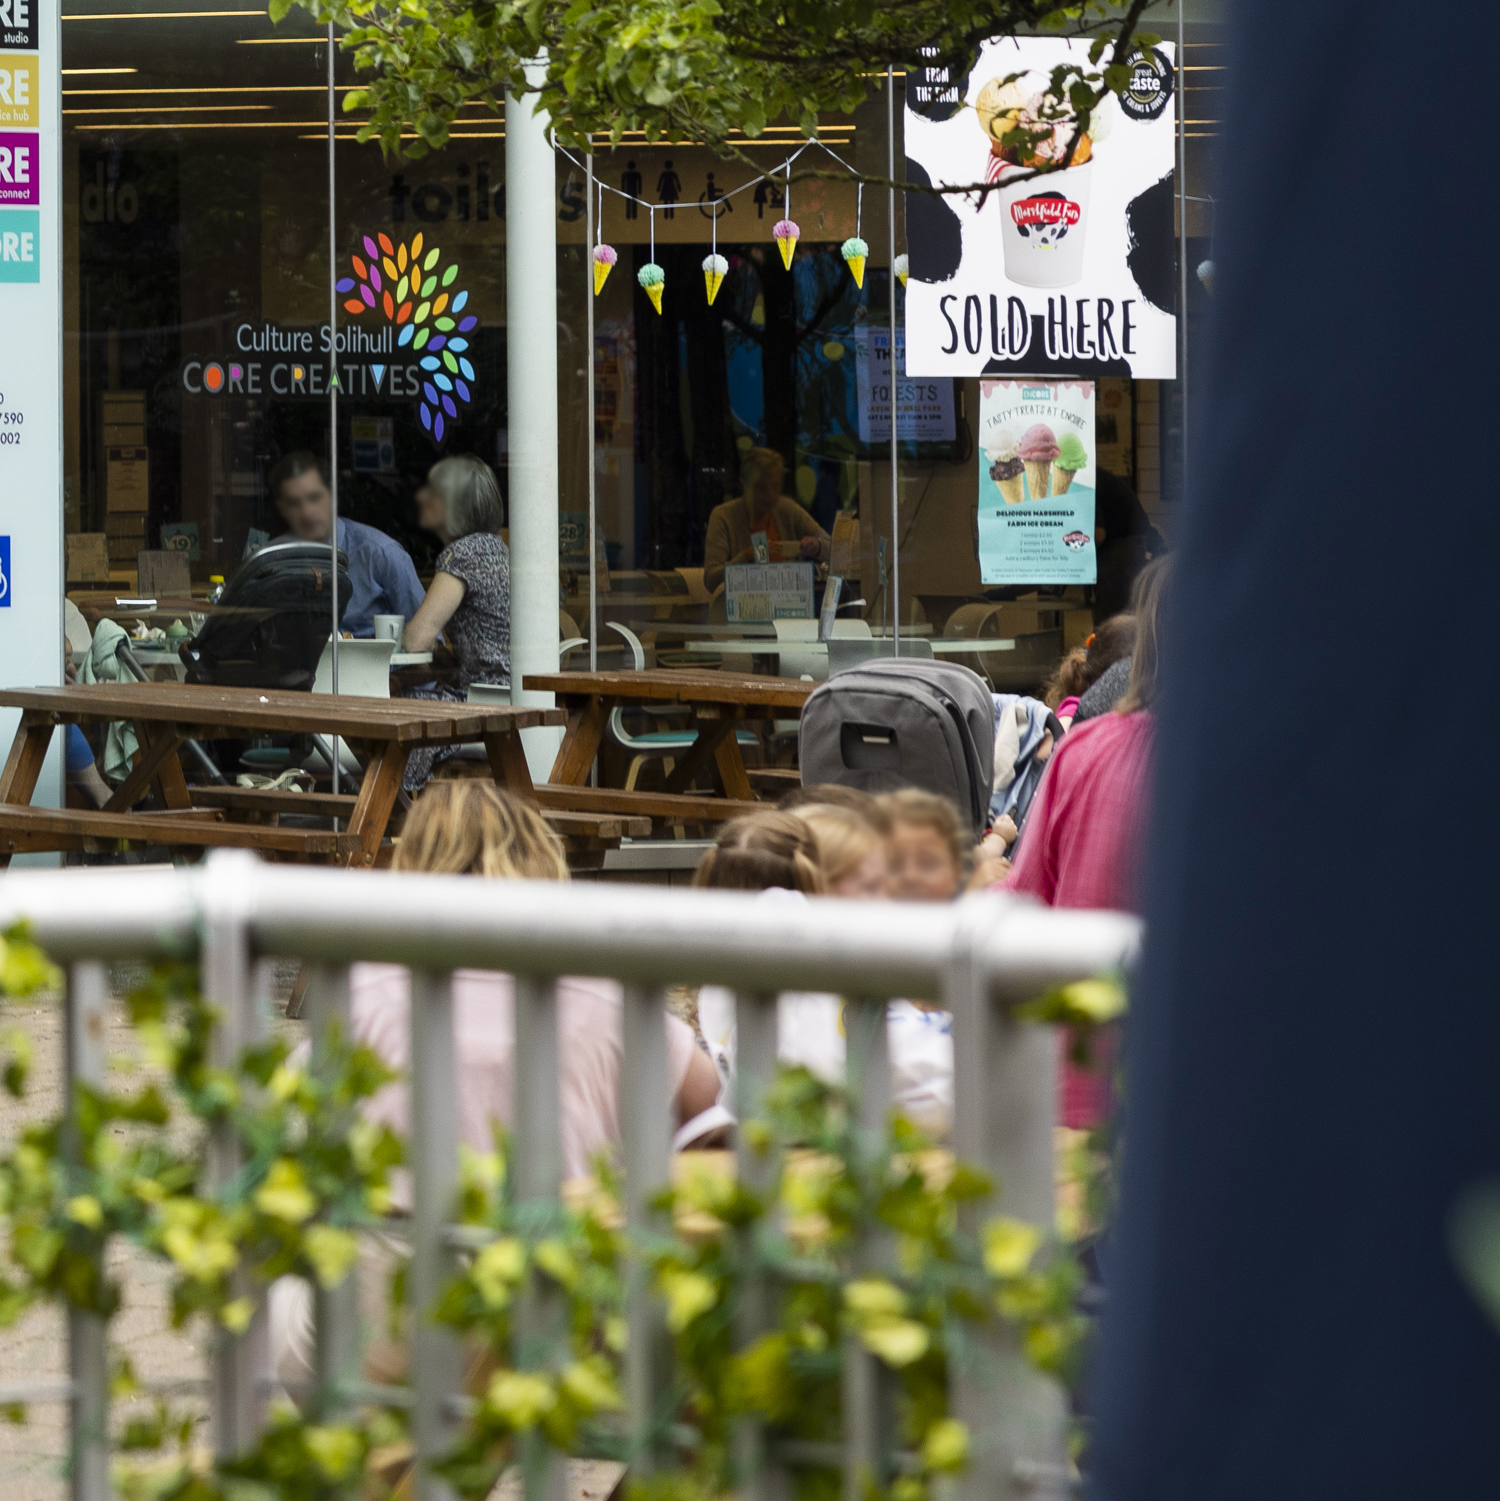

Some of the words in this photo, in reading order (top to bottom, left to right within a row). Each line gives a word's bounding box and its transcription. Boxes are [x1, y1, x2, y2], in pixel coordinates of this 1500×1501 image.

[4, 31, 29, 44] studio
[925, 67, 949, 84] FROM
[13, 110, 30, 121] hub
[1013, 202, 1061, 223] Marshfield
[1062, 202, 1079, 219] Farm
[940, 294, 1034, 360] SOLD
[1048, 296, 1138, 360] HERE
[236, 324, 313, 353] Culture
[320, 325, 393, 354] Solihull
[183, 361, 262, 393] CORE
[270, 363, 420, 396] CREATIVES
[872, 385, 938, 402] FOESTS
[986, 410, 1012, 429] TASTY
[1015, 403, 1045, 416] TREATS
[1047, 406, 1058, 417] AT
[1060, 411, 1087, 430] ENCORE
